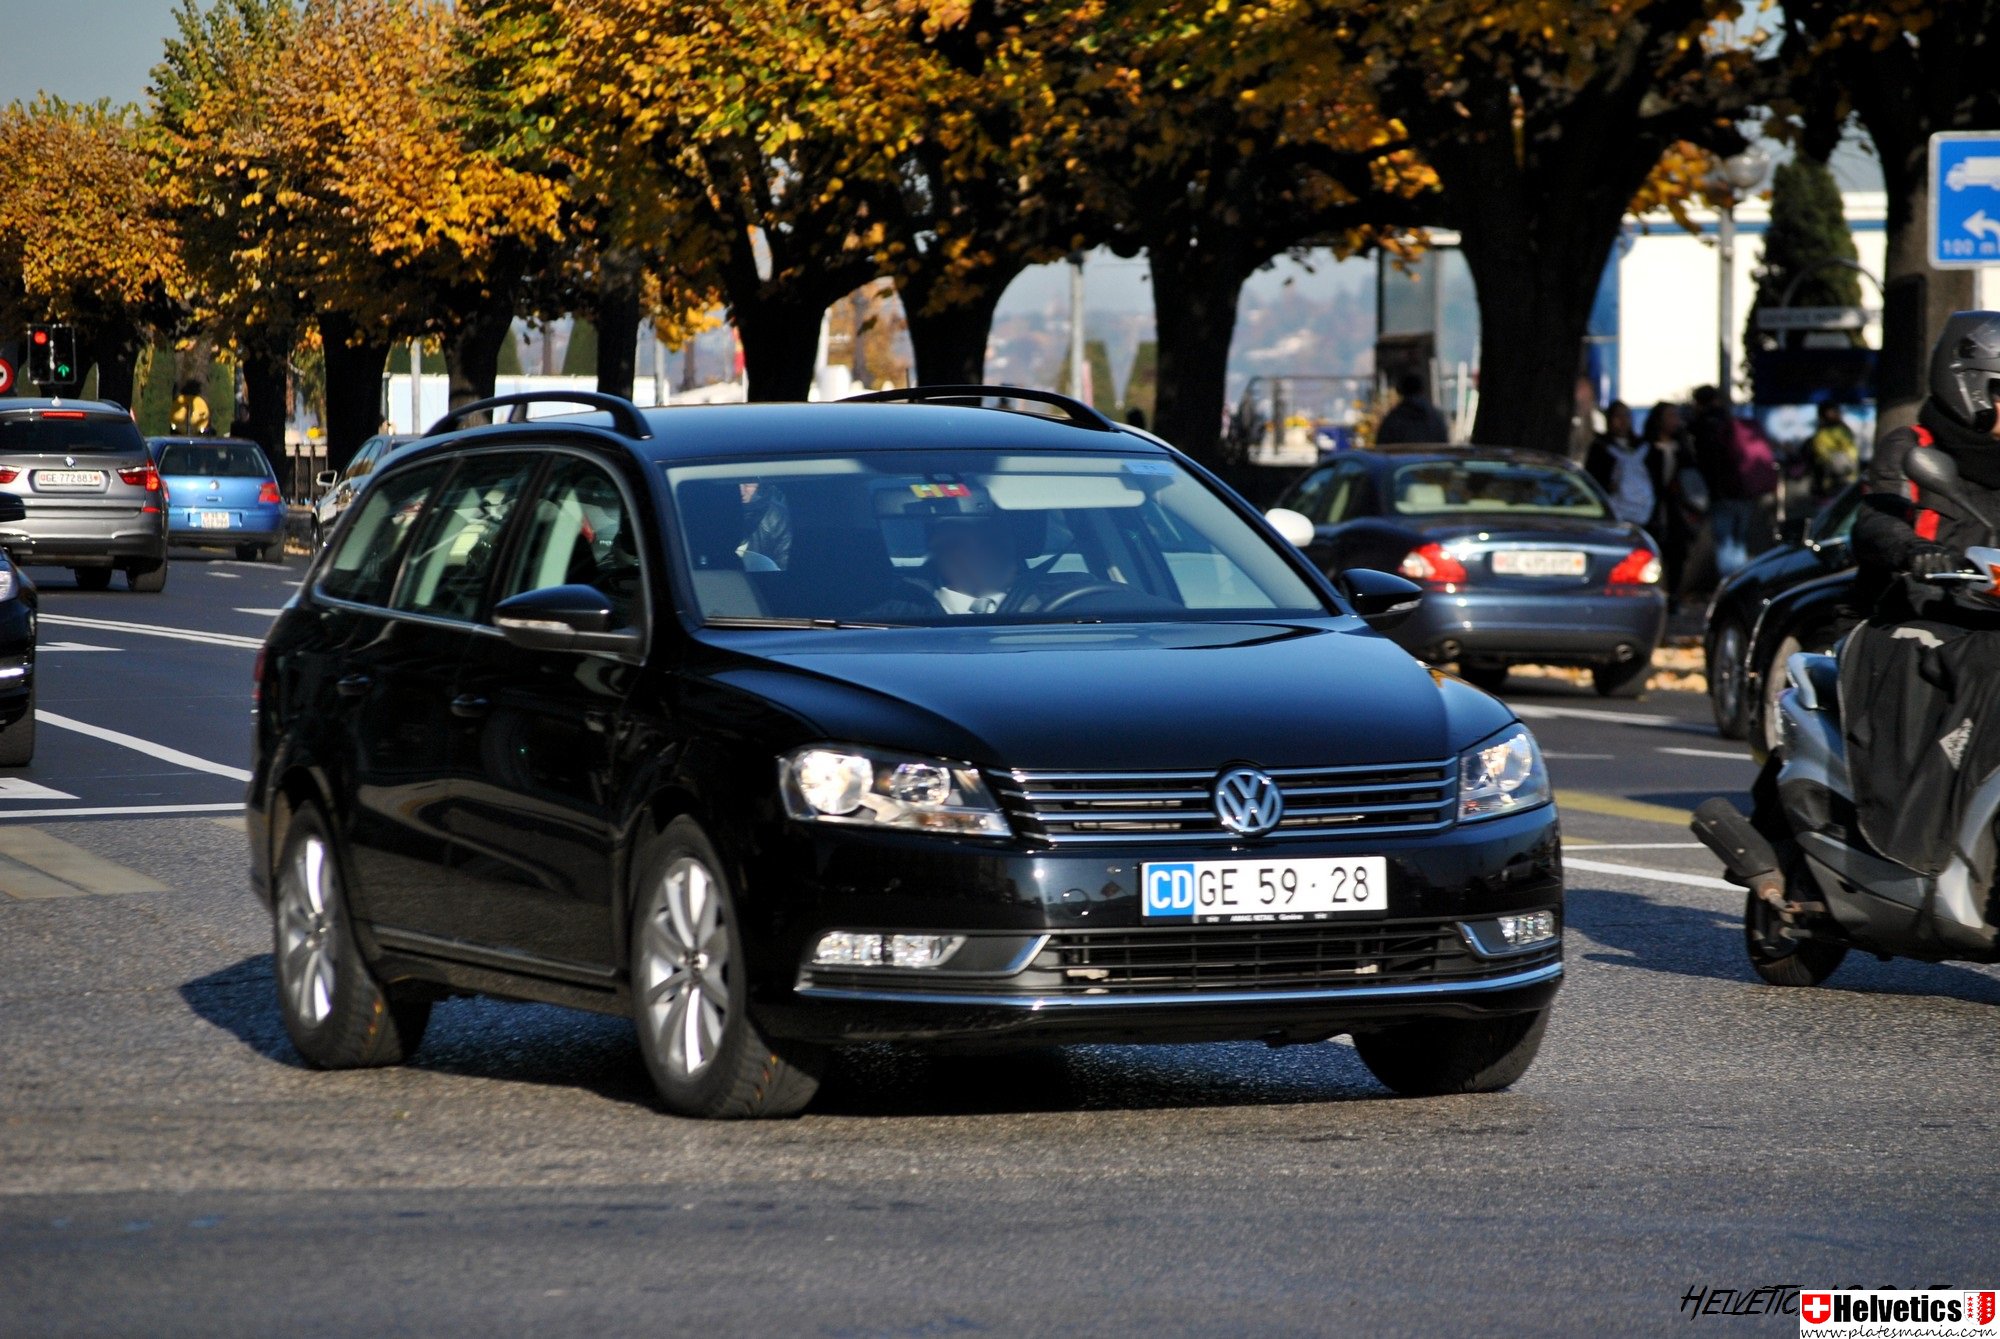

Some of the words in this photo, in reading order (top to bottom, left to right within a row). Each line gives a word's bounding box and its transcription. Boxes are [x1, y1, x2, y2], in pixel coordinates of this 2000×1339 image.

[1943, 239, 1974, 256] 100
[1150, 869, 1194, 909] CD
[1200, 869, 1238, 906] GE
[1259, 867, 1298, 904] 59
[1331, 866, 1369, 903] 28
